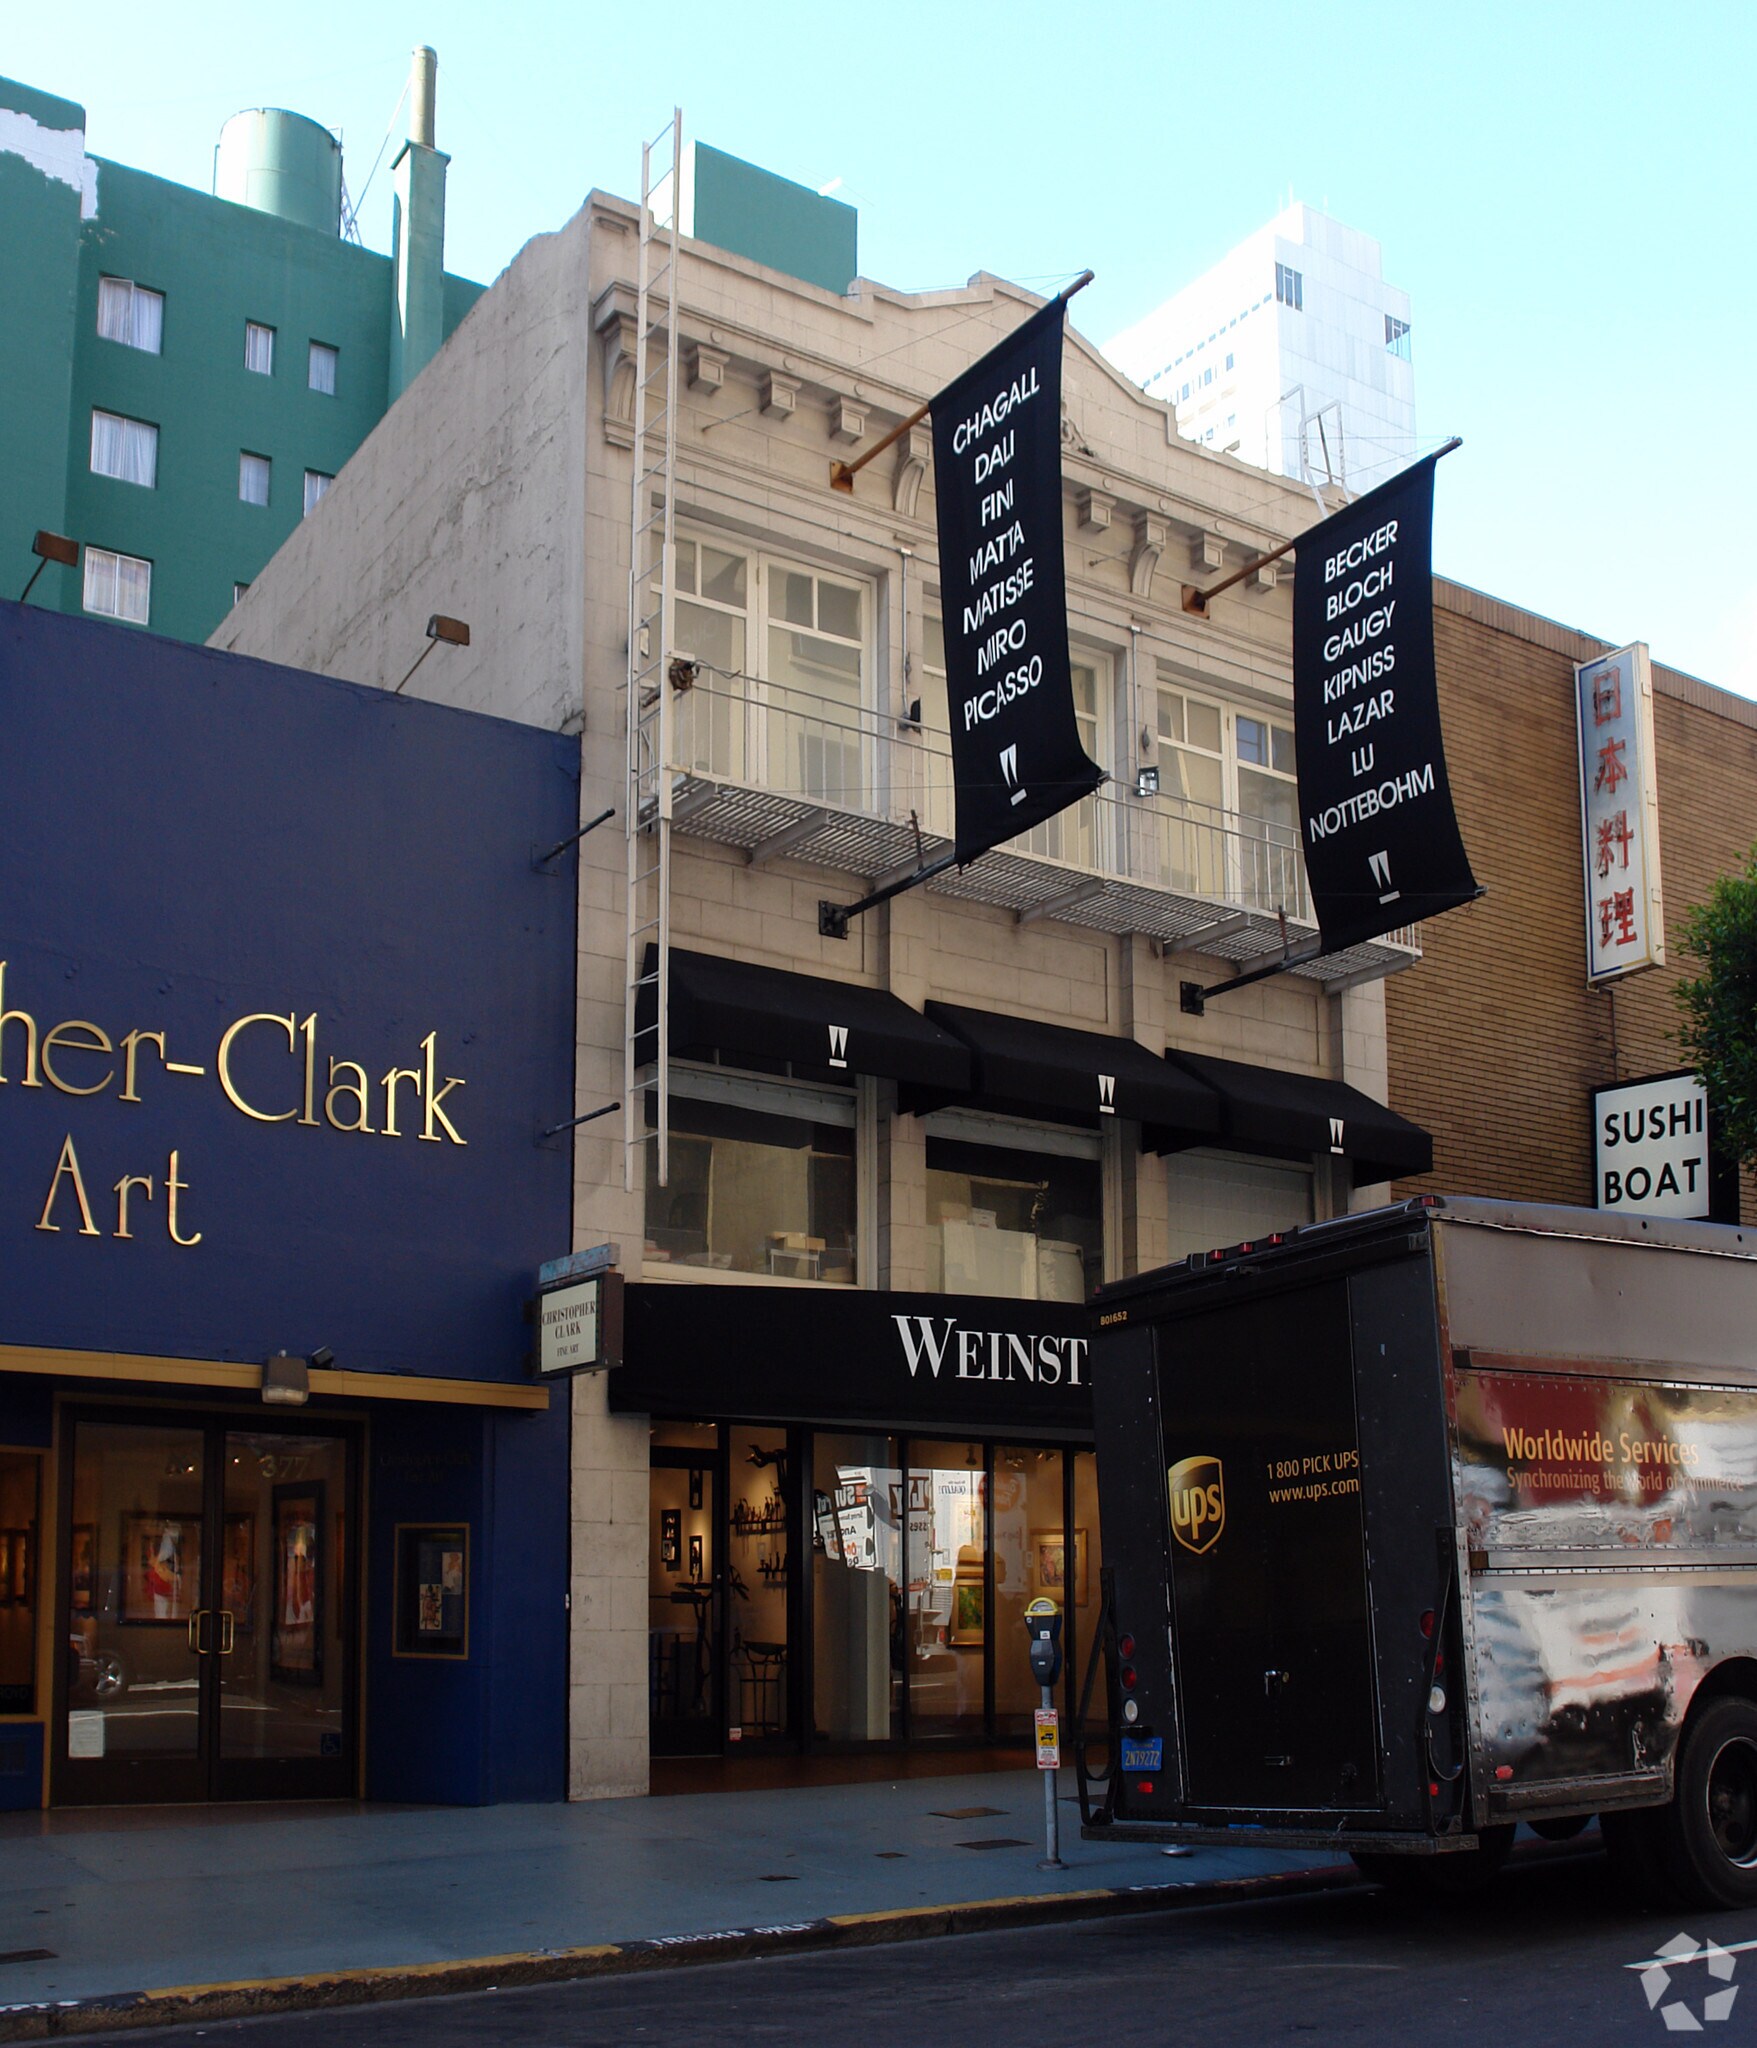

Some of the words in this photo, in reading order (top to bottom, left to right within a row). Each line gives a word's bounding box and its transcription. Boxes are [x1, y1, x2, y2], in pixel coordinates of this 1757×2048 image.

[952, 366, 1040, 455] CHAGALL
[974, 430, 1015, 485] DALI
[980, 478, 1015, 528] FINI
[969, 521, 1025, 586] MATTA
[1324, 520, 1398, 584] BECKER
[963, 558, 1034, 634] MATISSE
[1326, 562, 1393, 622] BLOCH
[977, 619, 1027, 676] MIRO
[1323, 601, 1396, 662] GAUGY
[964, 655, 1042, 731] PICASSO
[1323, 645, 1396, 704] KIPNISS
[1326, 690, 1395, 745] LAZAR
[1351, 743, 1374, 777] LU
[1309, 763, 1435, 843] NOTTEBOHM
[1593, 665, 1639, 948] 日本料理
[1603, 1098, 1703, 1147] SUSHI
[35, 1132, 202, 1246] Art
[1604, 1157, 1702, 1205] BOAT
[542, 1301, 596, 1326] CHRISTOPHER
[554, 1321, 581, 1340] CLARK
[569, 1343, 579, 1354] ART
[890, 1314, 1093, 1386] WEINST
[1267, 1463, 1273, 1479] 1
[1276, 1459, 1300, 1477] 800
[1303, 1455, 1331, 1475] PICK
[1334, 1450, 1360, 1470] UPS
[1502, 1427, 1614, 1462] Worldwide
[1619, 1432, 1700, 1466] Services
[1269, 1479, 1360, 1503] www.ups.com
[1506, 1466, 1600, 1495] Synchronizing
[1603, 1470, 1624, 1491] the
[1173, 1484, 1222, 1540] ups
